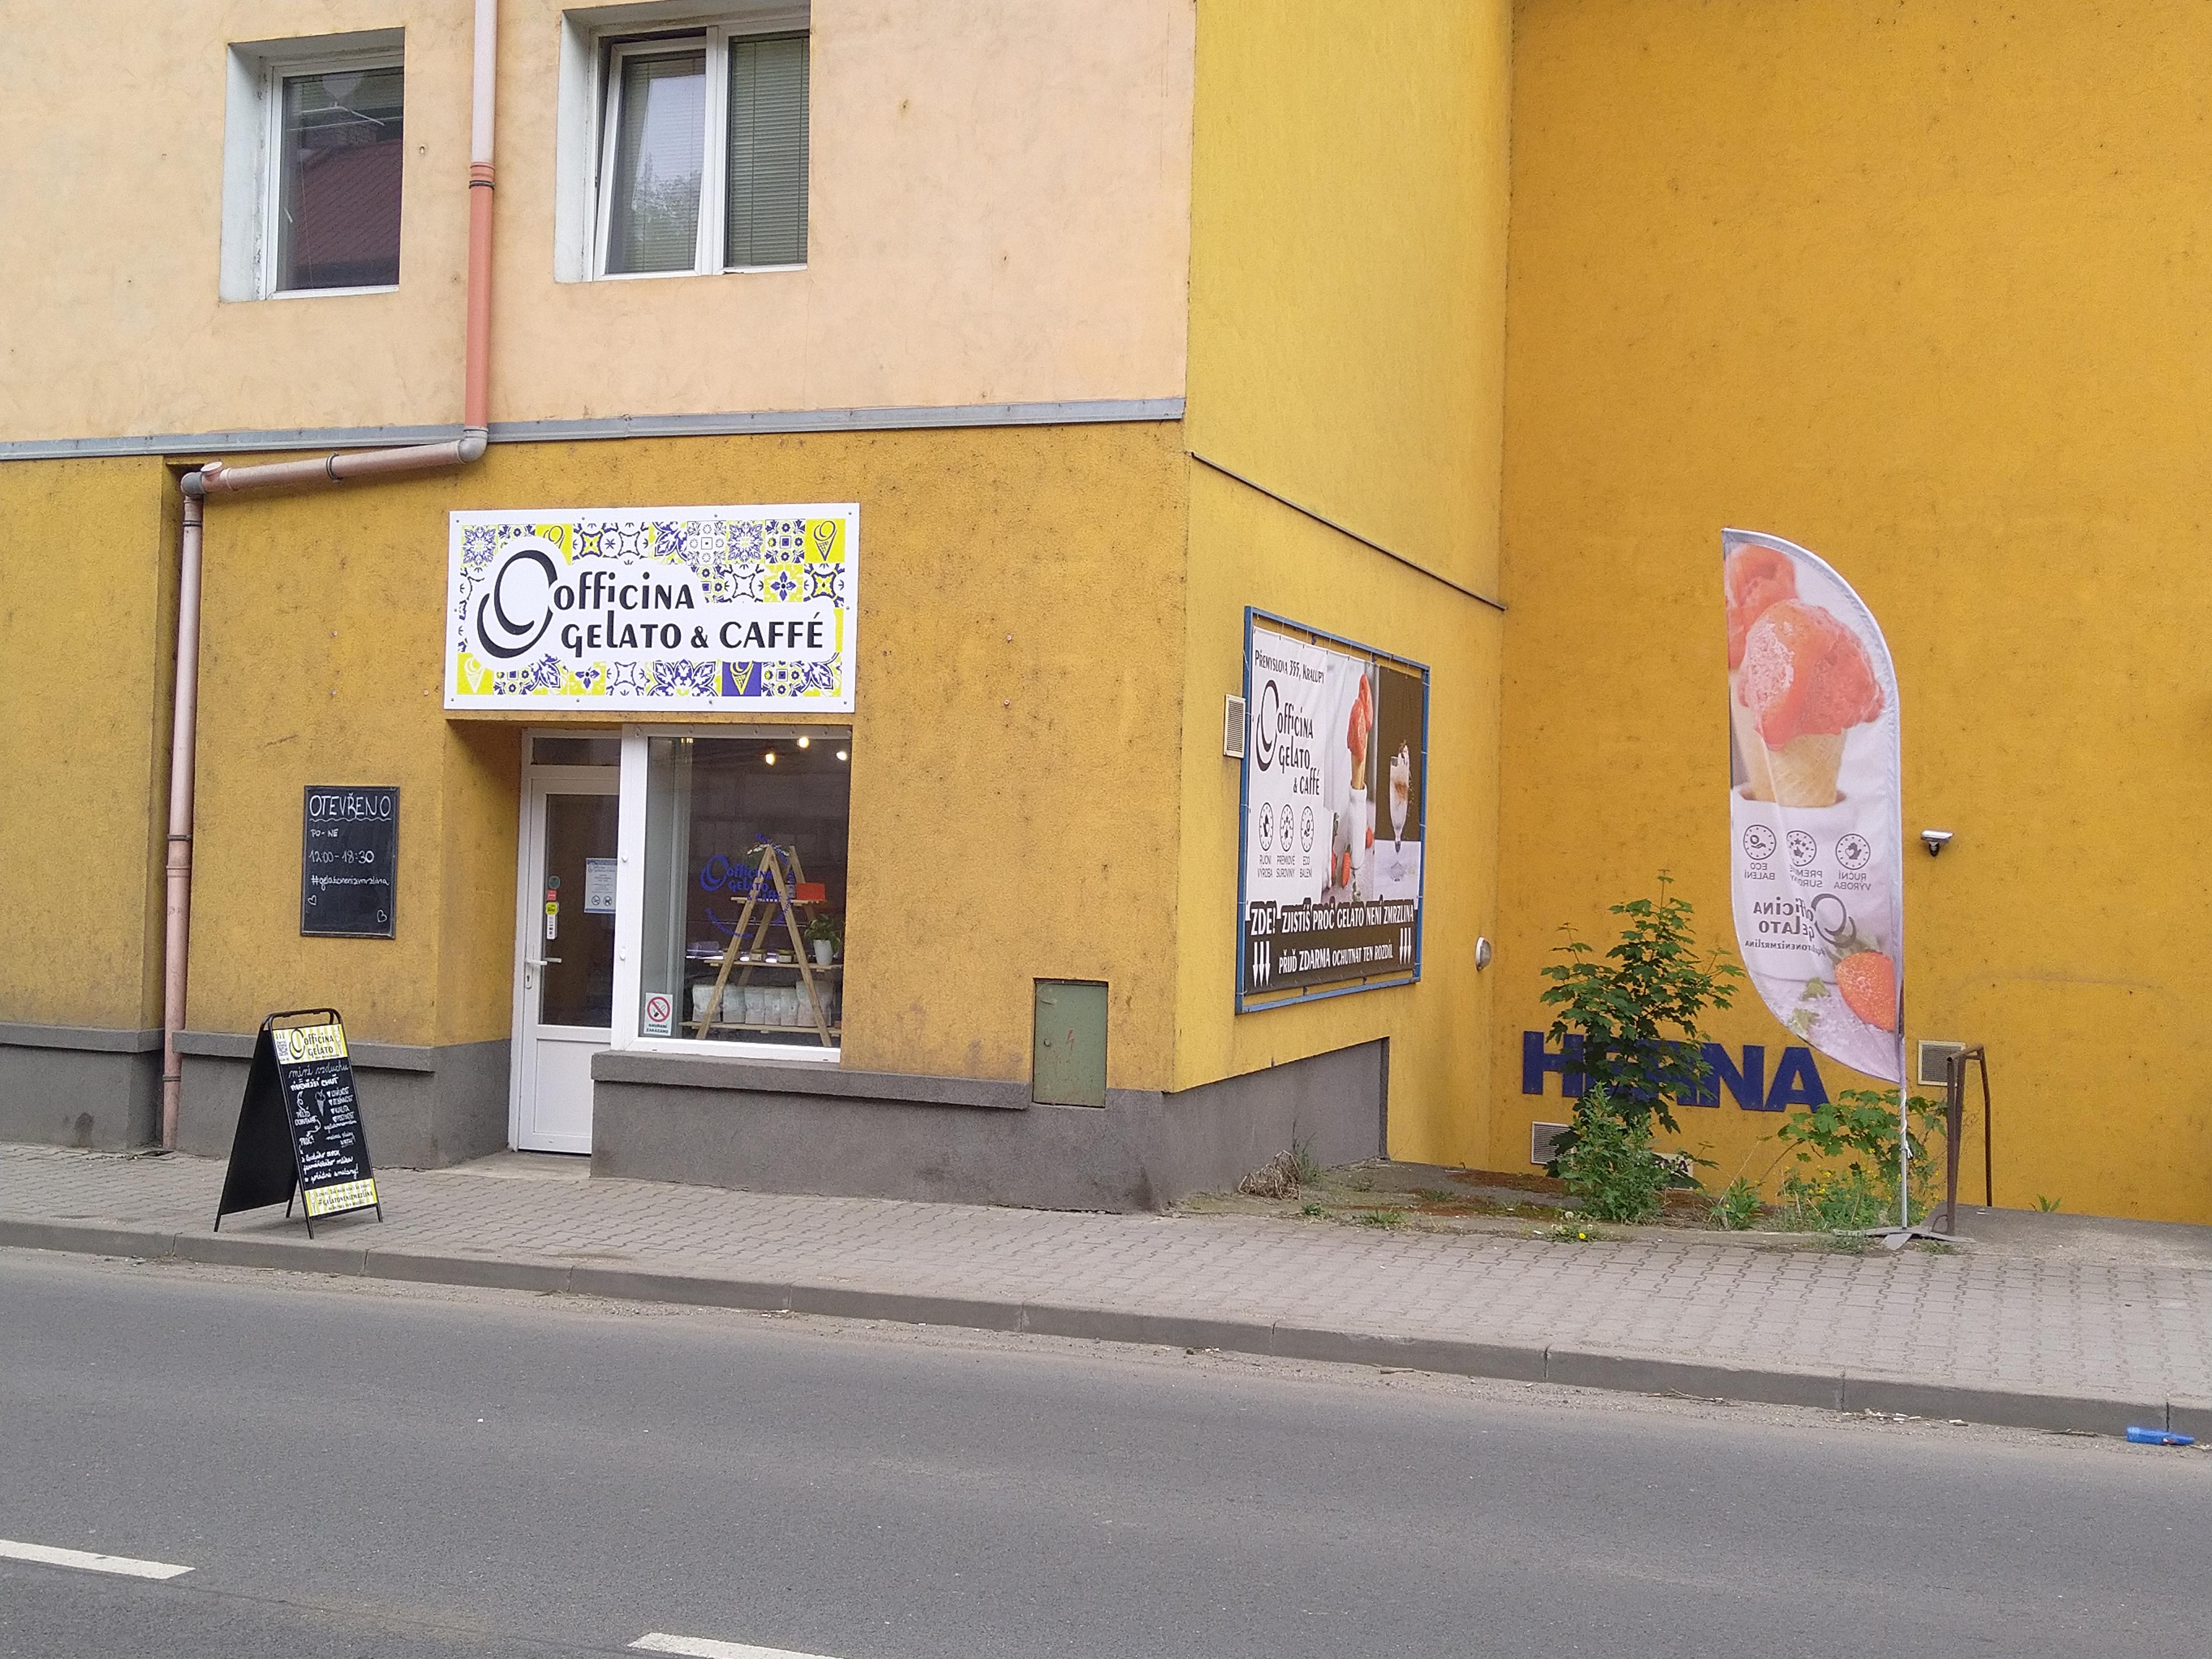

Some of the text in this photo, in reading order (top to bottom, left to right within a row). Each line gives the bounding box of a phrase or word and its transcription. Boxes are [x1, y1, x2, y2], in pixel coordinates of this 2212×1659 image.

[691, 626, 708, 648] &
[719, 612, 823, 648] CAFFÉ
[1290, 660, 1301, 681] 355,
[1293, 778, 1297, 793] &
[310, 793, 391, 817] OTEVŘENO
[1251, 901, 1413, 936] ZDE! ZJISTÍŠ PROČ GELATO NENÍ ZMRZLINA
[1279, 939, 1392, 974] PŘIJĎ ZDARMA OCHUTNAT TEN ROZDÍL
